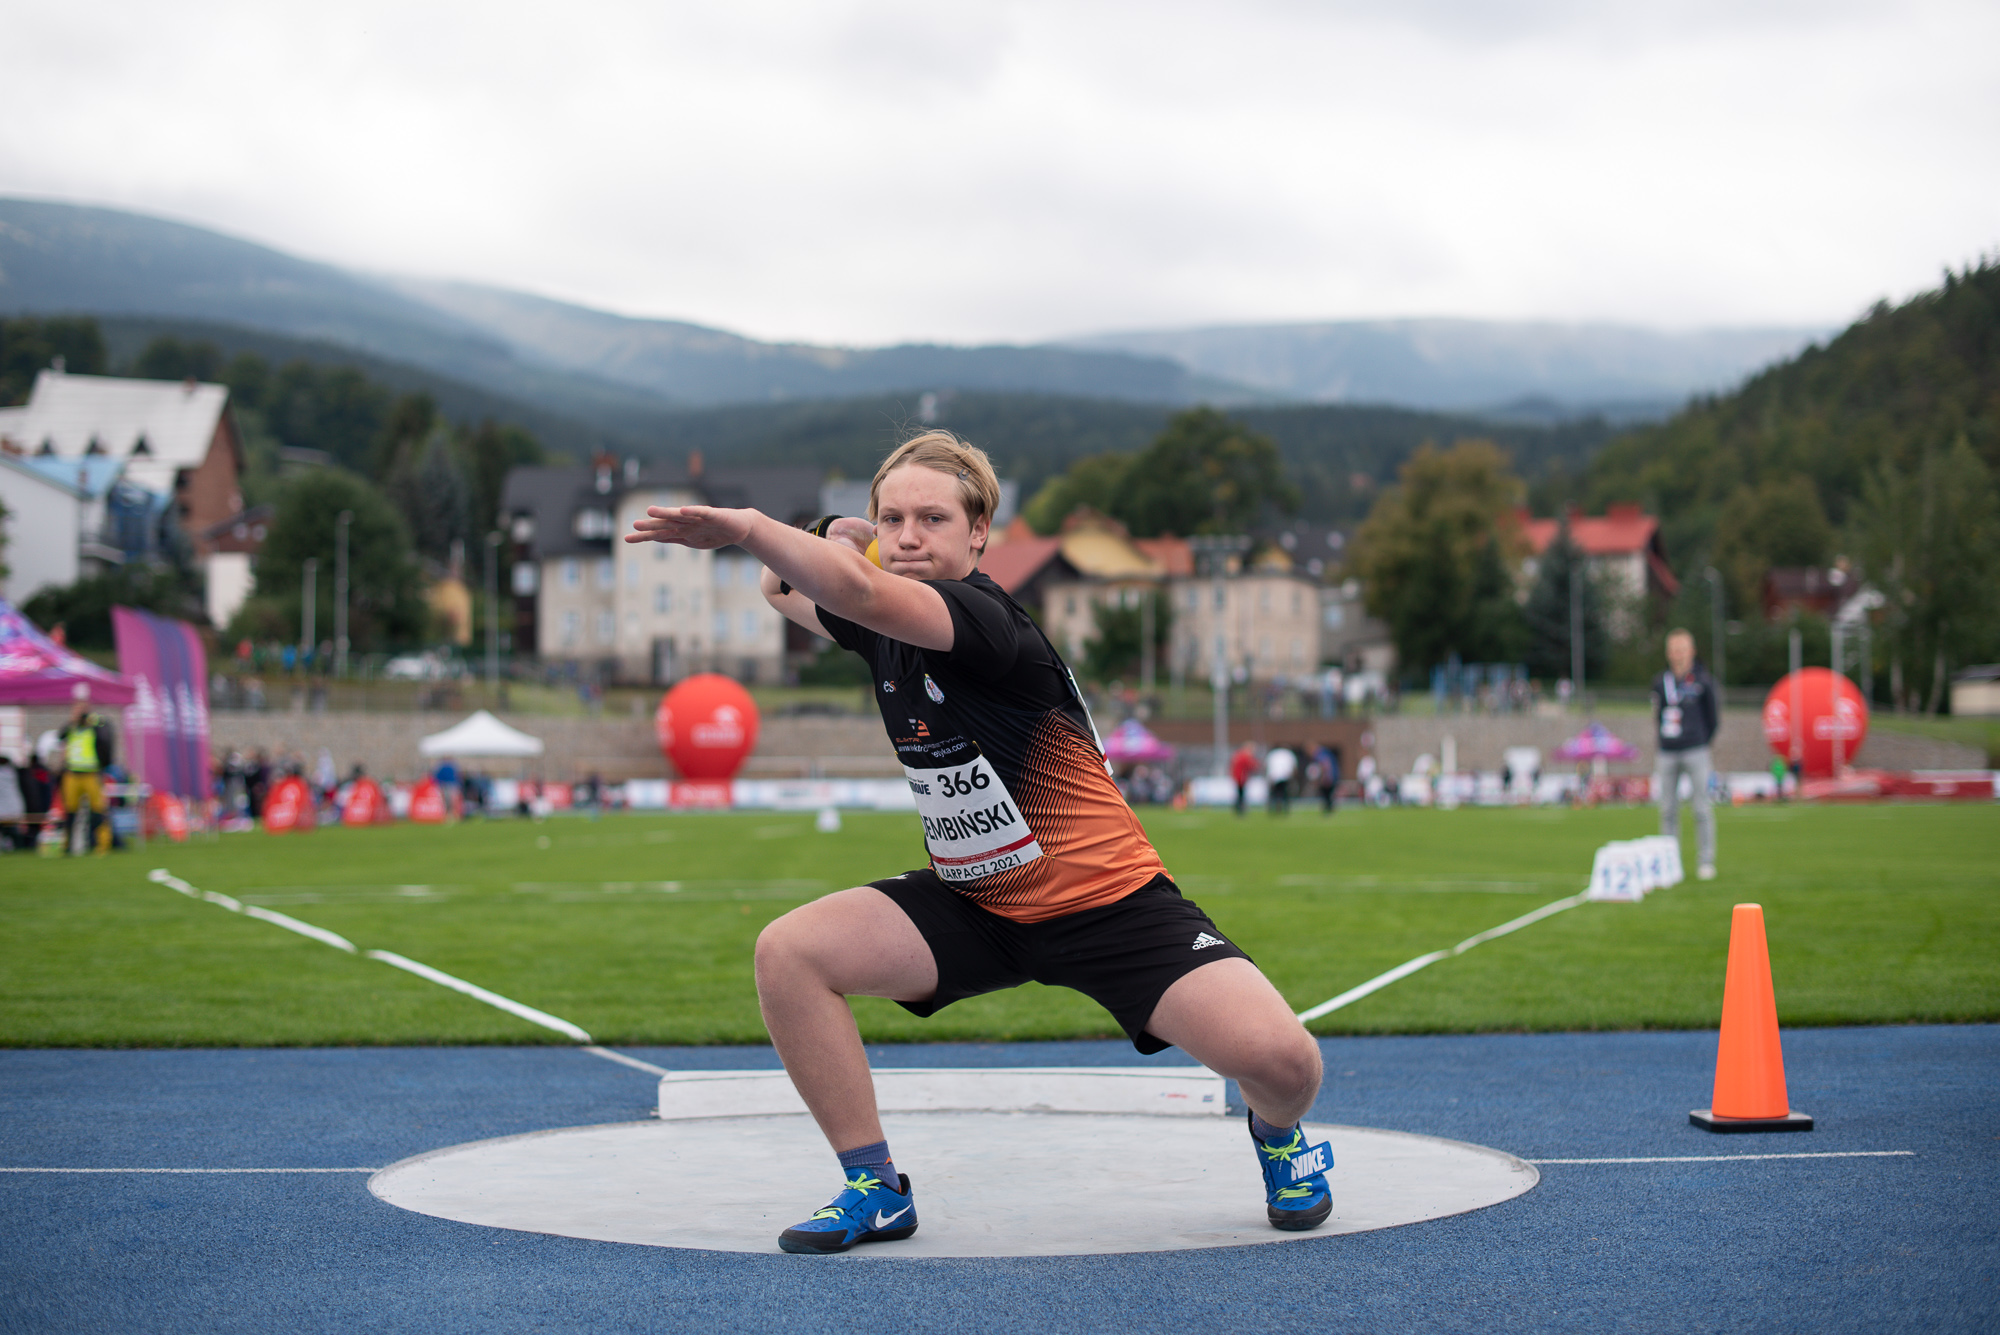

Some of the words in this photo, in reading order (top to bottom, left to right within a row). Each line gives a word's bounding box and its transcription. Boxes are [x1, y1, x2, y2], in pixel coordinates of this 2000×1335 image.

[937, 764, 990, 798] 366
[921, 800, 1016, 841] EMBIŃSKI
[941, 864, 989, 880] KARPACZ
[989, 853, 1022, 872] 2021
[1602, 864, 1632, 894] 12
[1192, 939, 1226, 951] adidas
[1290, 1146, 1327, 1182] NIKE
